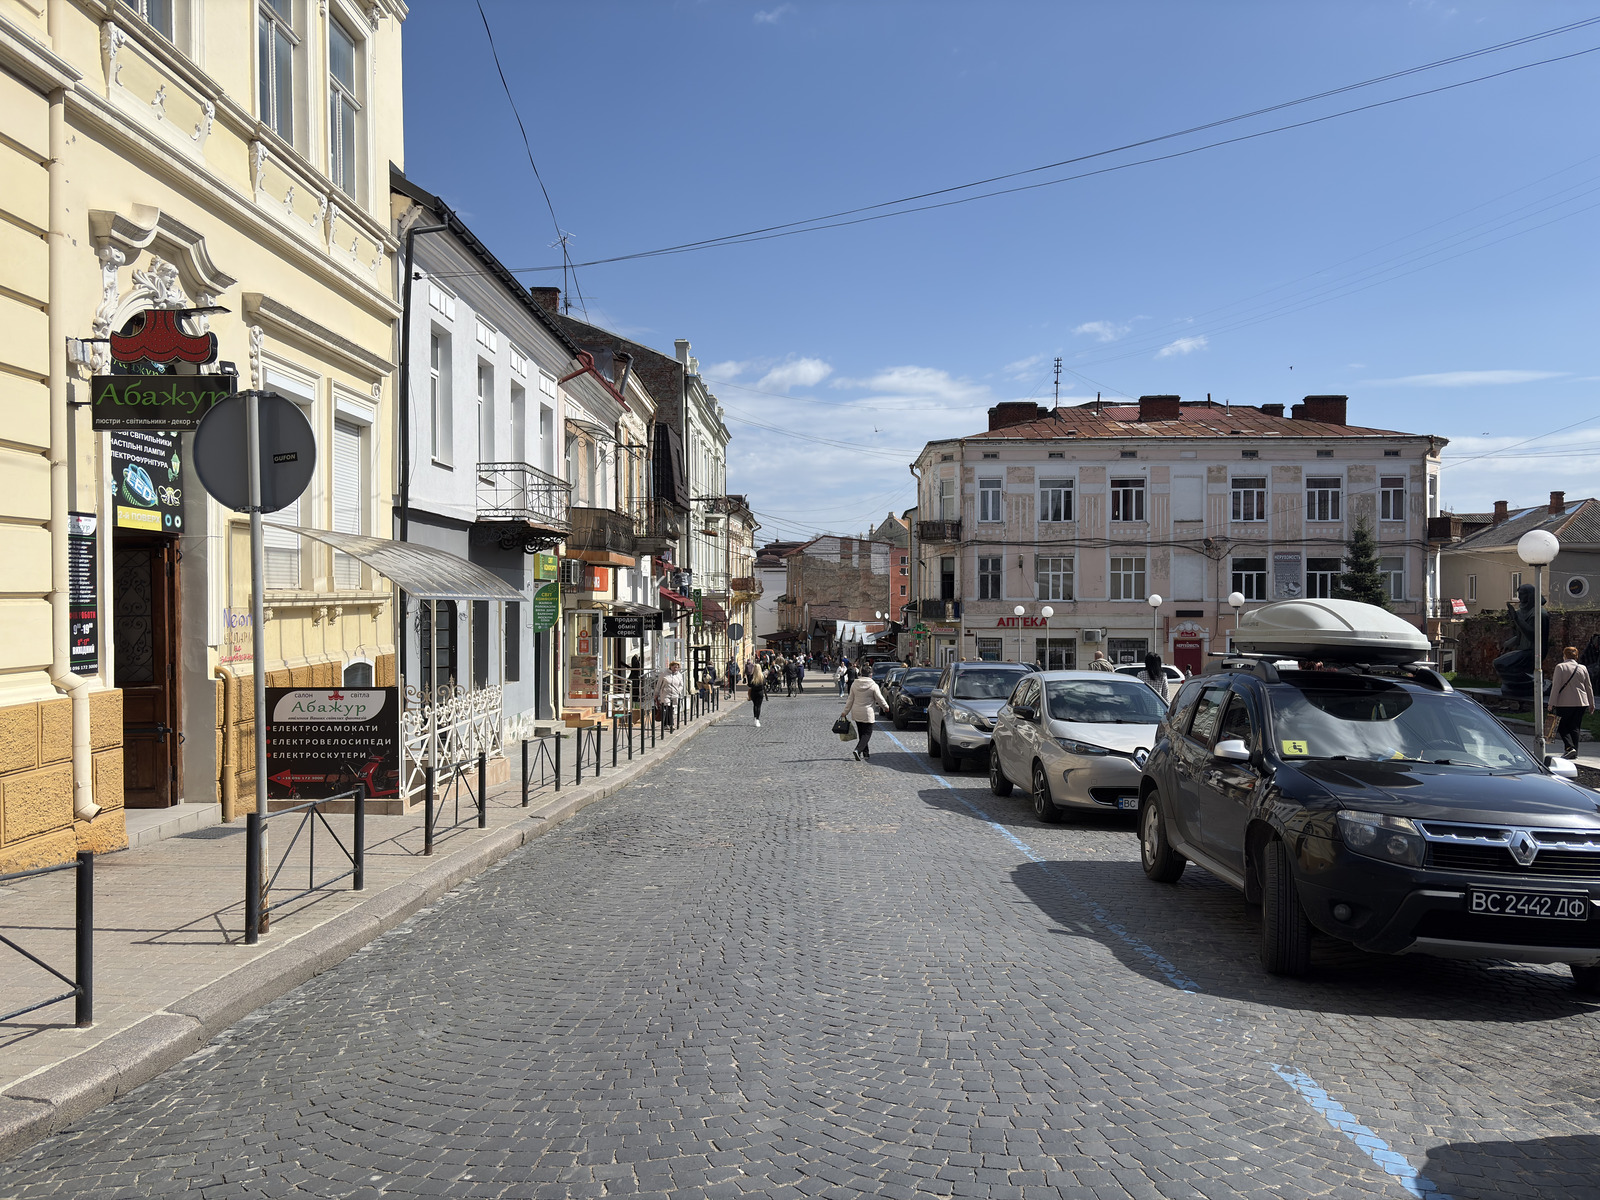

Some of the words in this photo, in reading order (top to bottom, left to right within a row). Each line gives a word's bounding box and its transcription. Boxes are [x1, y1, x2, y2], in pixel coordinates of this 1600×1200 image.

[126, 417, 166, 425] світильники
[130, 431, 172, 447] СВІТИЛЬНИКИ
[143, 446, 166, 457] ЛАМПИ
[110, 450, 169, 469] ЛЕКТРОФУРНІТУРА
[126, 470, 152, 501] LED
[118, 510, 129, 519] 2-й
[131, 513, 160, 524] ПОВЕРХ
[996, 616, 1048, 627] АПТЕКА
[291, 700, 367, 717] Абажур
[272, 738, 391, 746] ЕЛЕКТРОВЕЛОСИПЕДИ
[1505, 895, 1551, 916] 2442
[1554, 898, 1585, 917] ДФ
